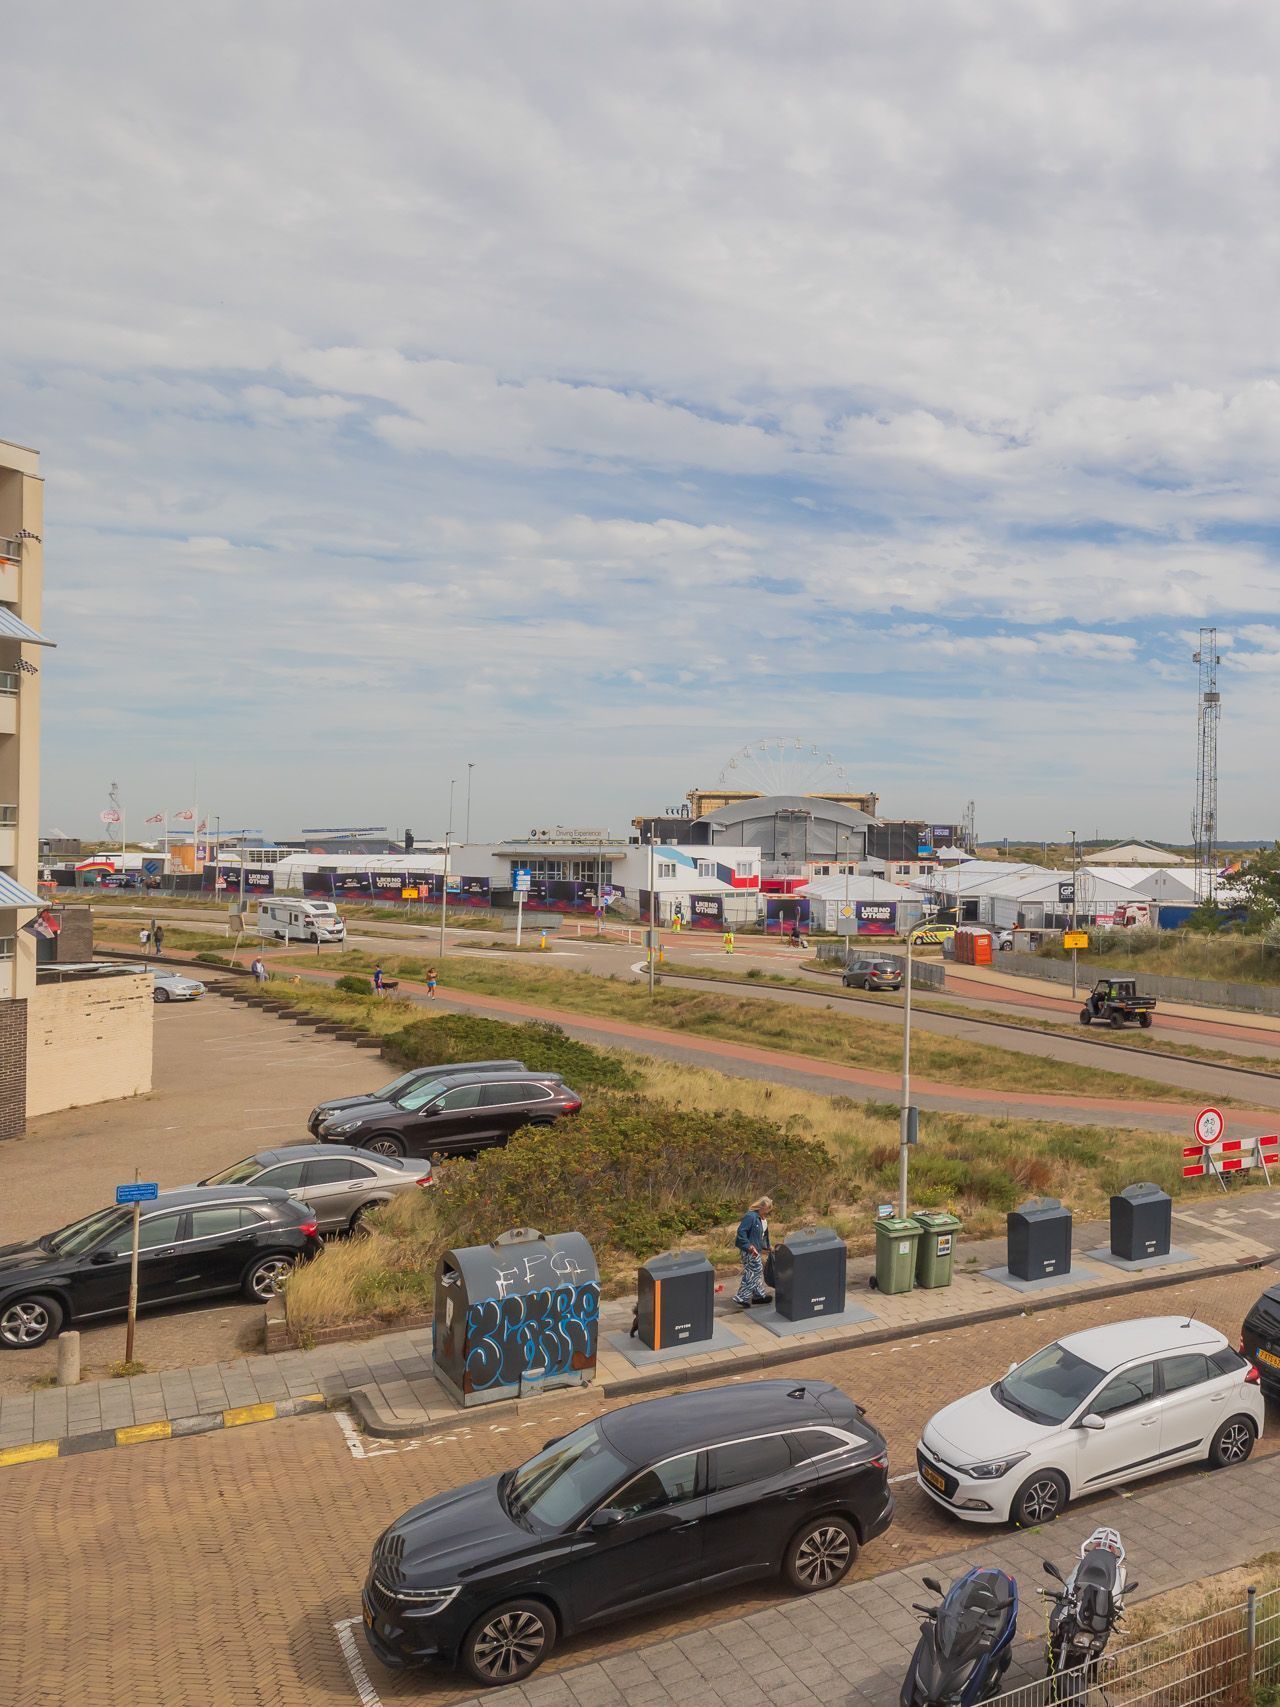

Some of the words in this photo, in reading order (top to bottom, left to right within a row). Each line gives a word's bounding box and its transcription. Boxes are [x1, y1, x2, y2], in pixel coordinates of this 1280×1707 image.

[555, 830, 573, 838] Driving
[574, 830, 601, 838] Experience
[1060, 886, 1074, 895] GP
[695, 907, 718, 915] OTHER
